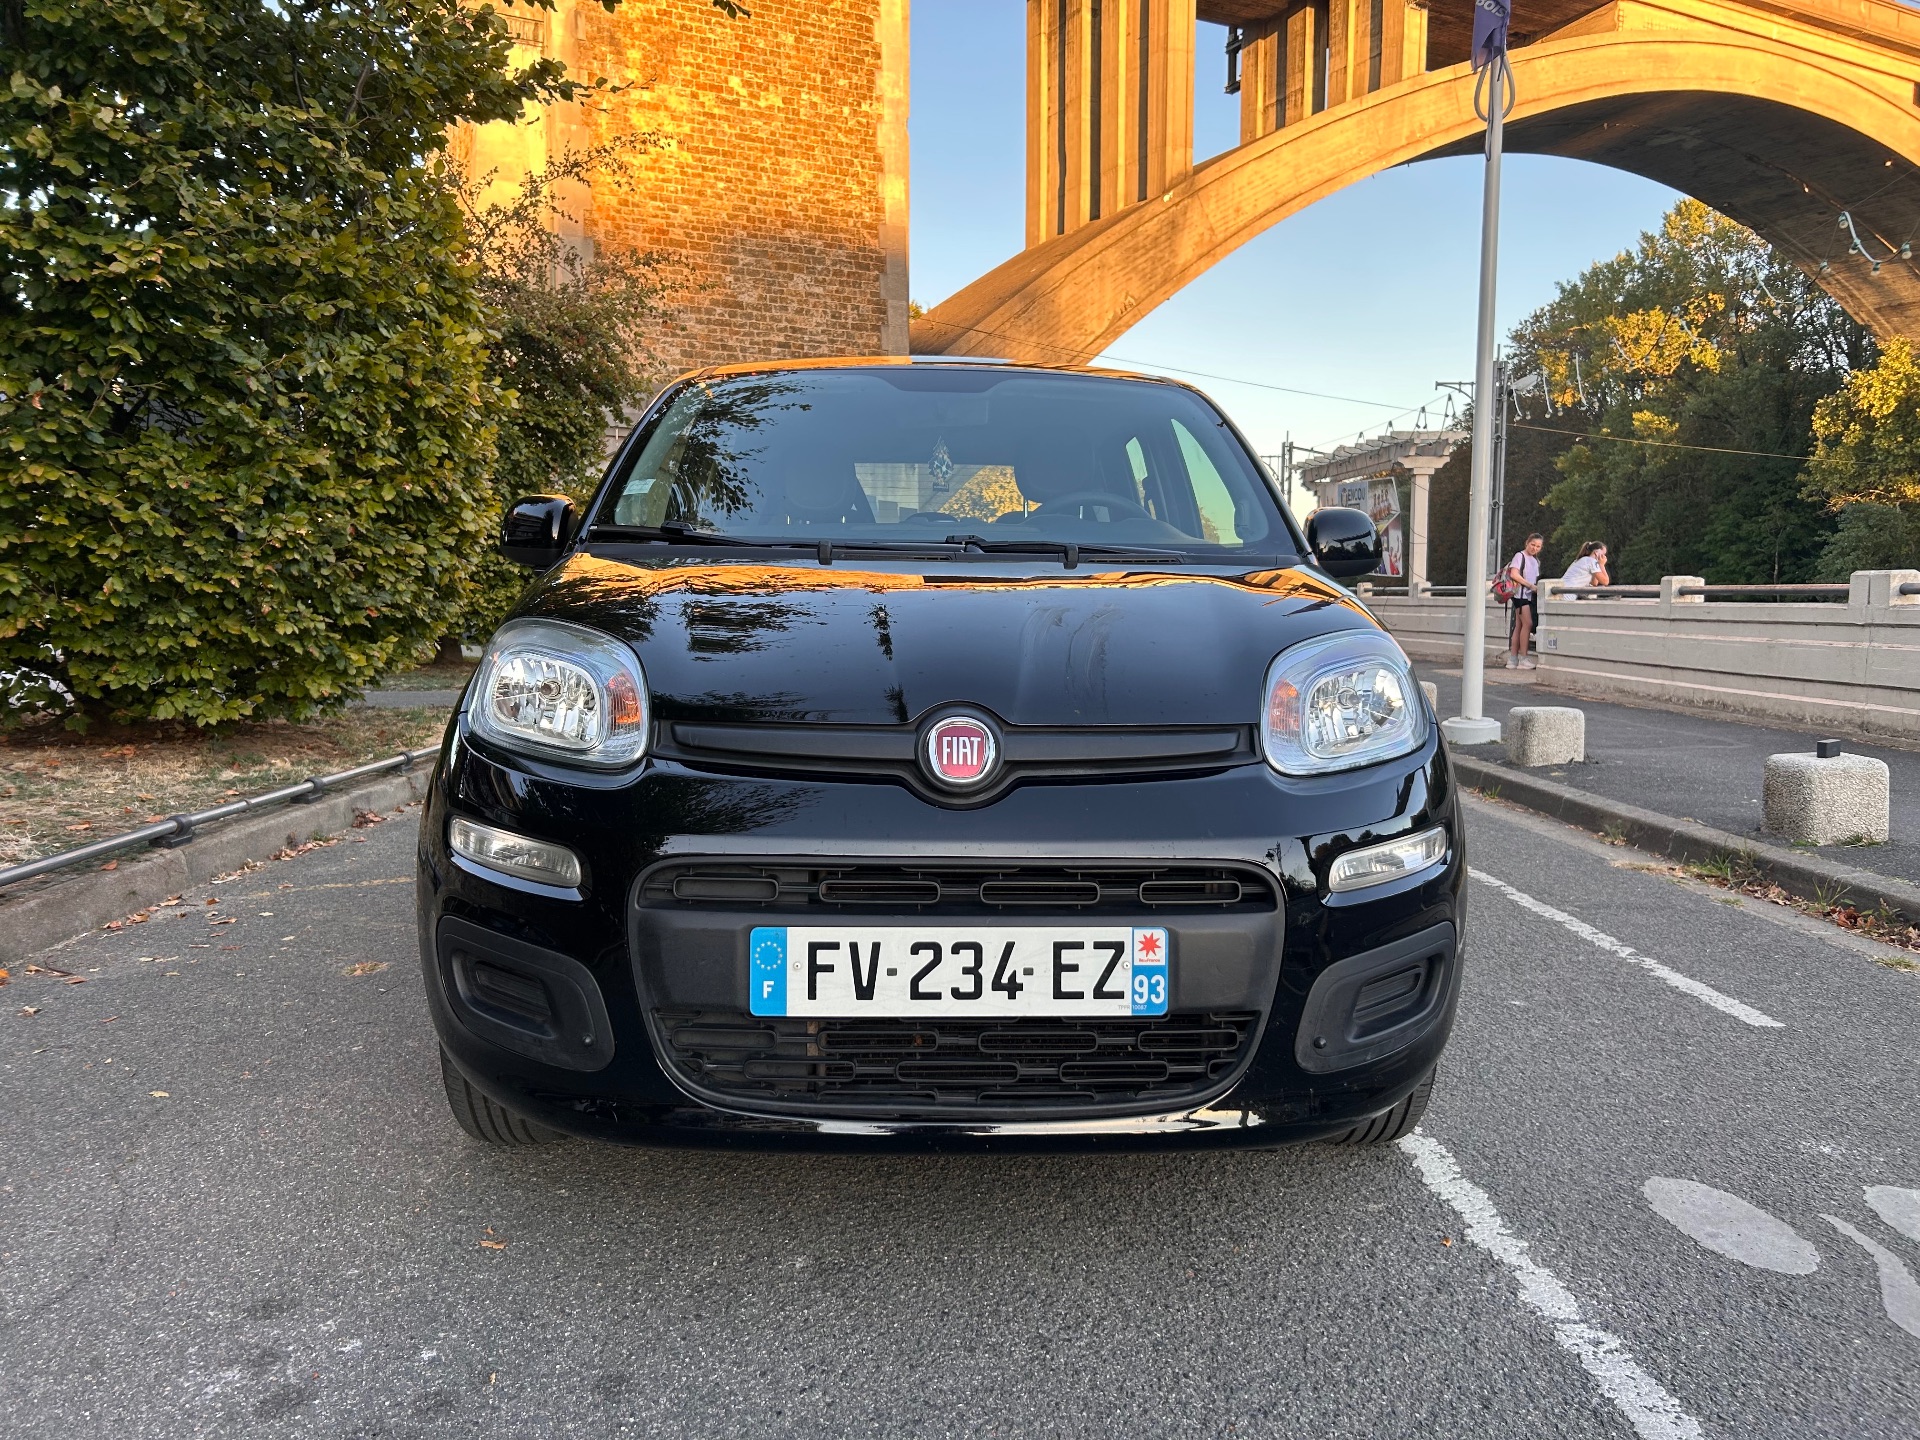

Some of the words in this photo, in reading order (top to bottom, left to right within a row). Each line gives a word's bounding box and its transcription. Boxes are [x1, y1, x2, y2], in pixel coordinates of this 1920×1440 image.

[942, 736, 981, 766] FIAT
[807, 941, 1125, 1000] FV-234-EZ
[763, 980, 775, 998] F
[1134, 974, 1165, 1004] 93
